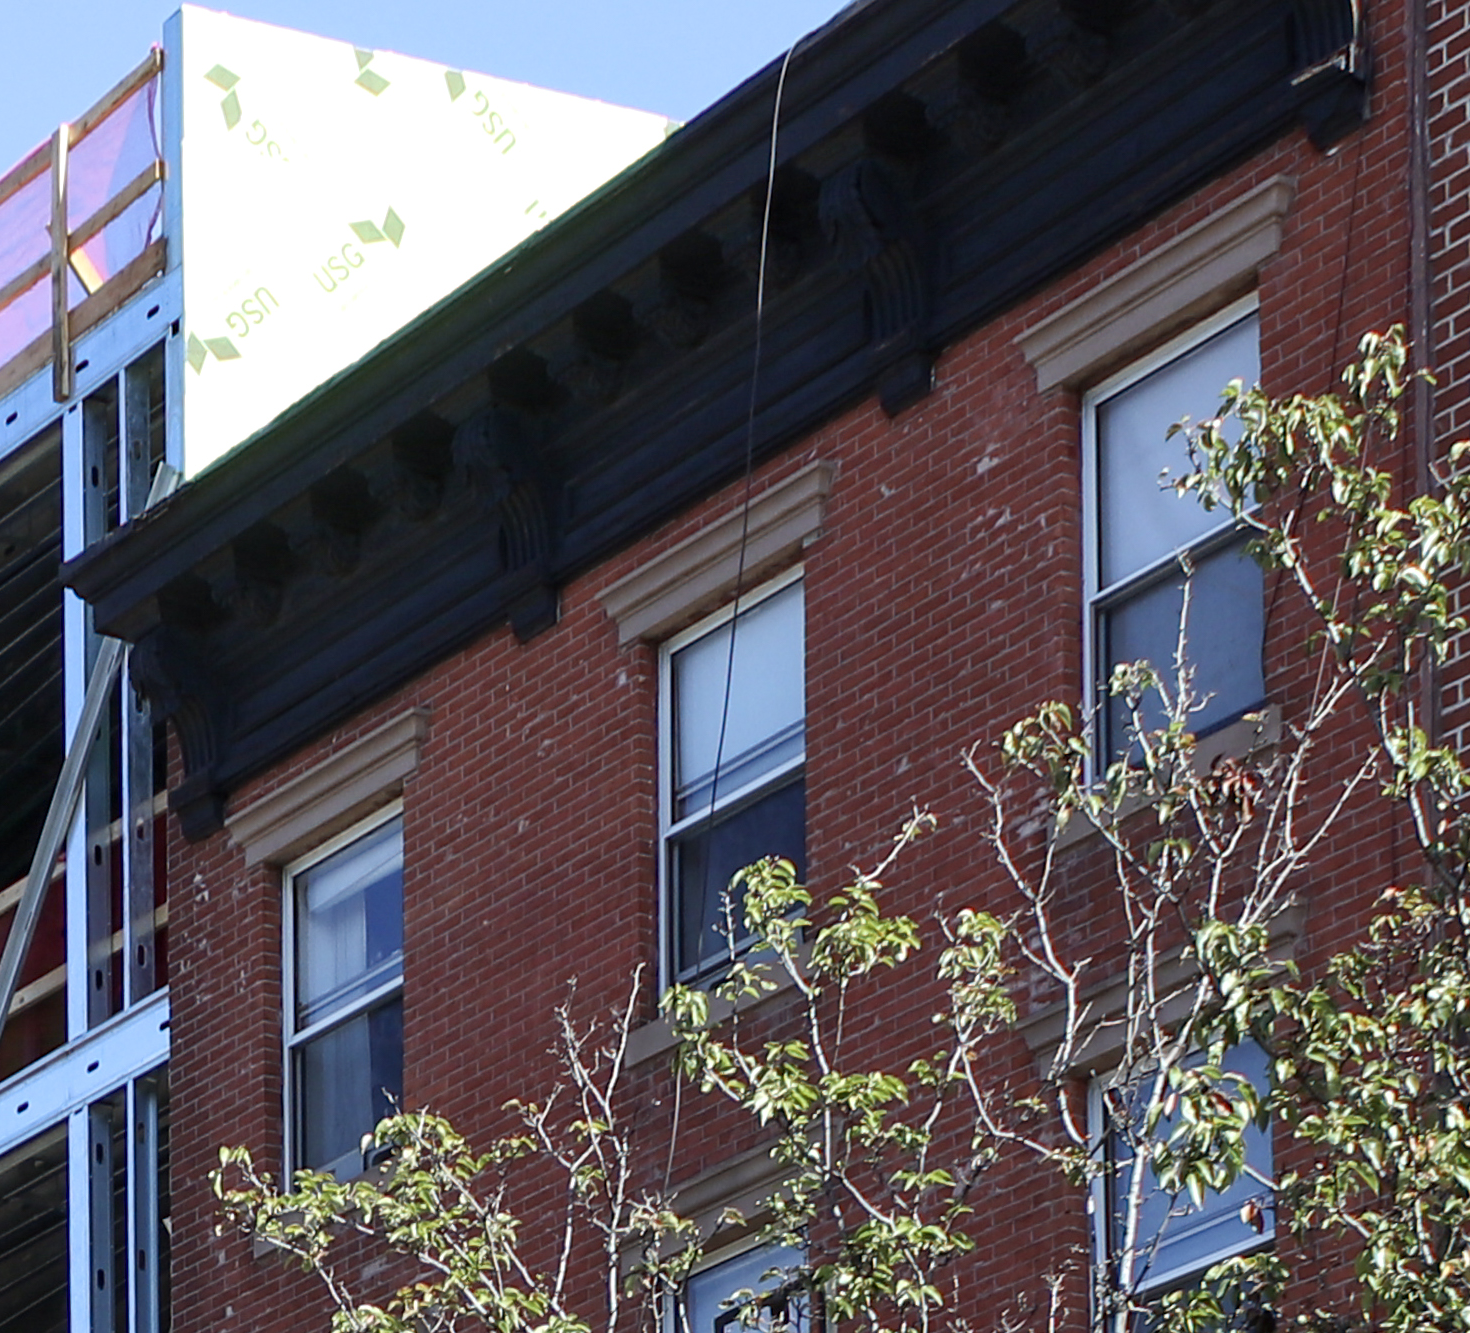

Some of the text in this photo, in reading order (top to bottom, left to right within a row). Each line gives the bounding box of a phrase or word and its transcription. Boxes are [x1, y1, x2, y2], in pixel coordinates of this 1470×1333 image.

[472, 89, 517, 155] USG
[312, 242, 365, 293] USG
[225, 286, 280, 338] USG
